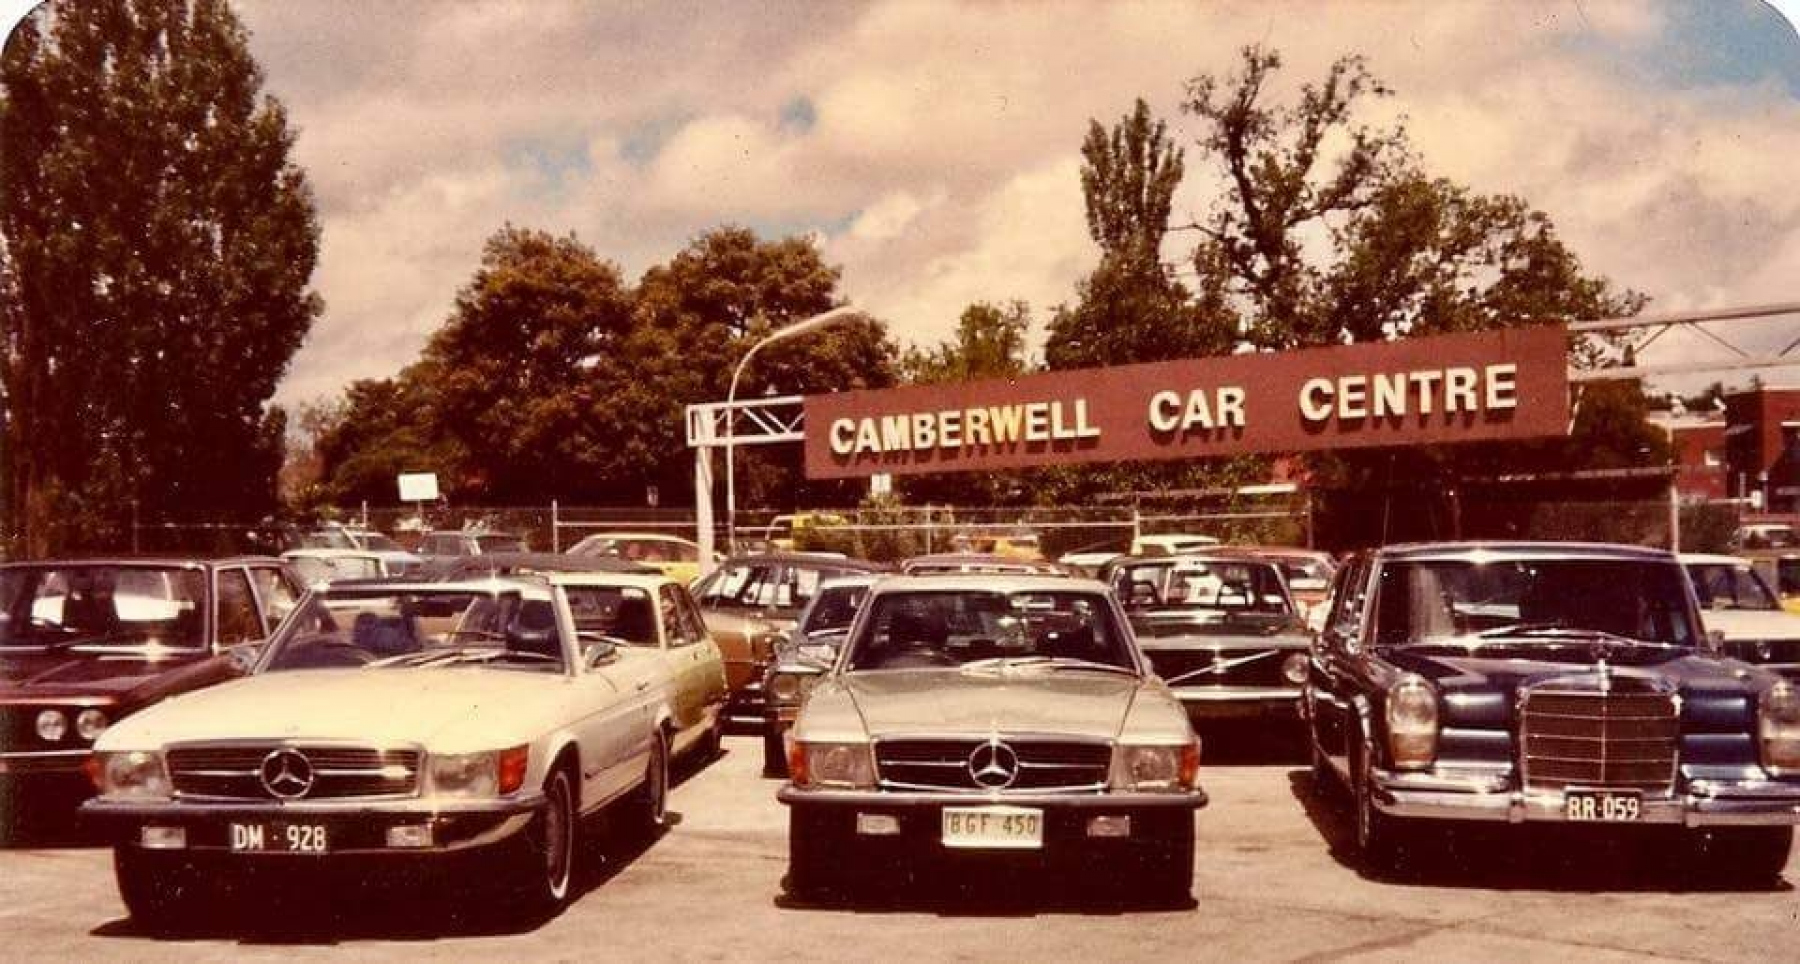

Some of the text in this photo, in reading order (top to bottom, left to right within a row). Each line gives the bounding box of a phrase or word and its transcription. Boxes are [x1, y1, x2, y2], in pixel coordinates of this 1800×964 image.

[829, 363, 1517, 454] CAMBERWELL CAR CENTRE
[950, 813, 1036, 835] BGF 450
